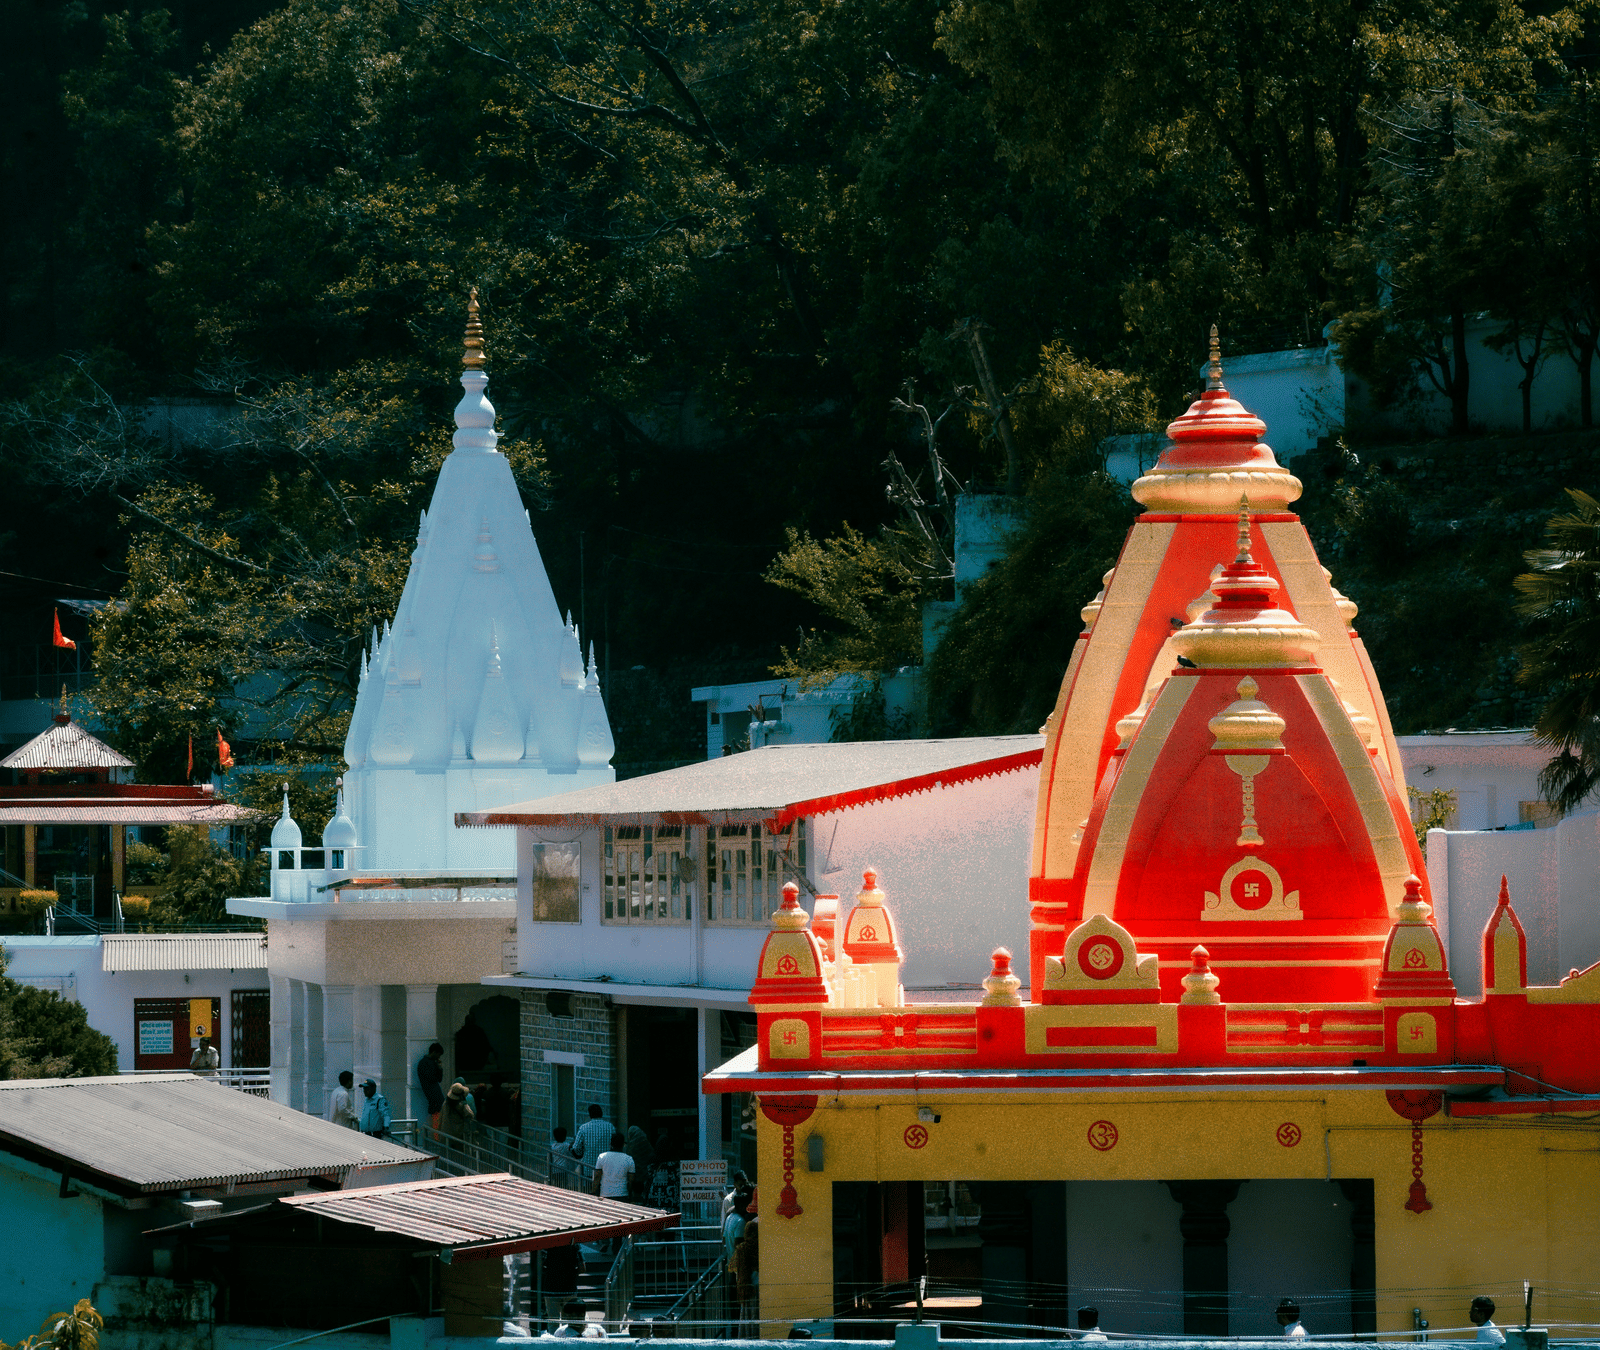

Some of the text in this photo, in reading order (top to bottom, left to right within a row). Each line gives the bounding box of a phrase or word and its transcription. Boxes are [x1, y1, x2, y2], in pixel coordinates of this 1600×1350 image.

[698, 1162, 726, 1170] PHOTO
[699, 1176, 726, 1184] SELFIE
[681, 1192, 691, 1200] NO
